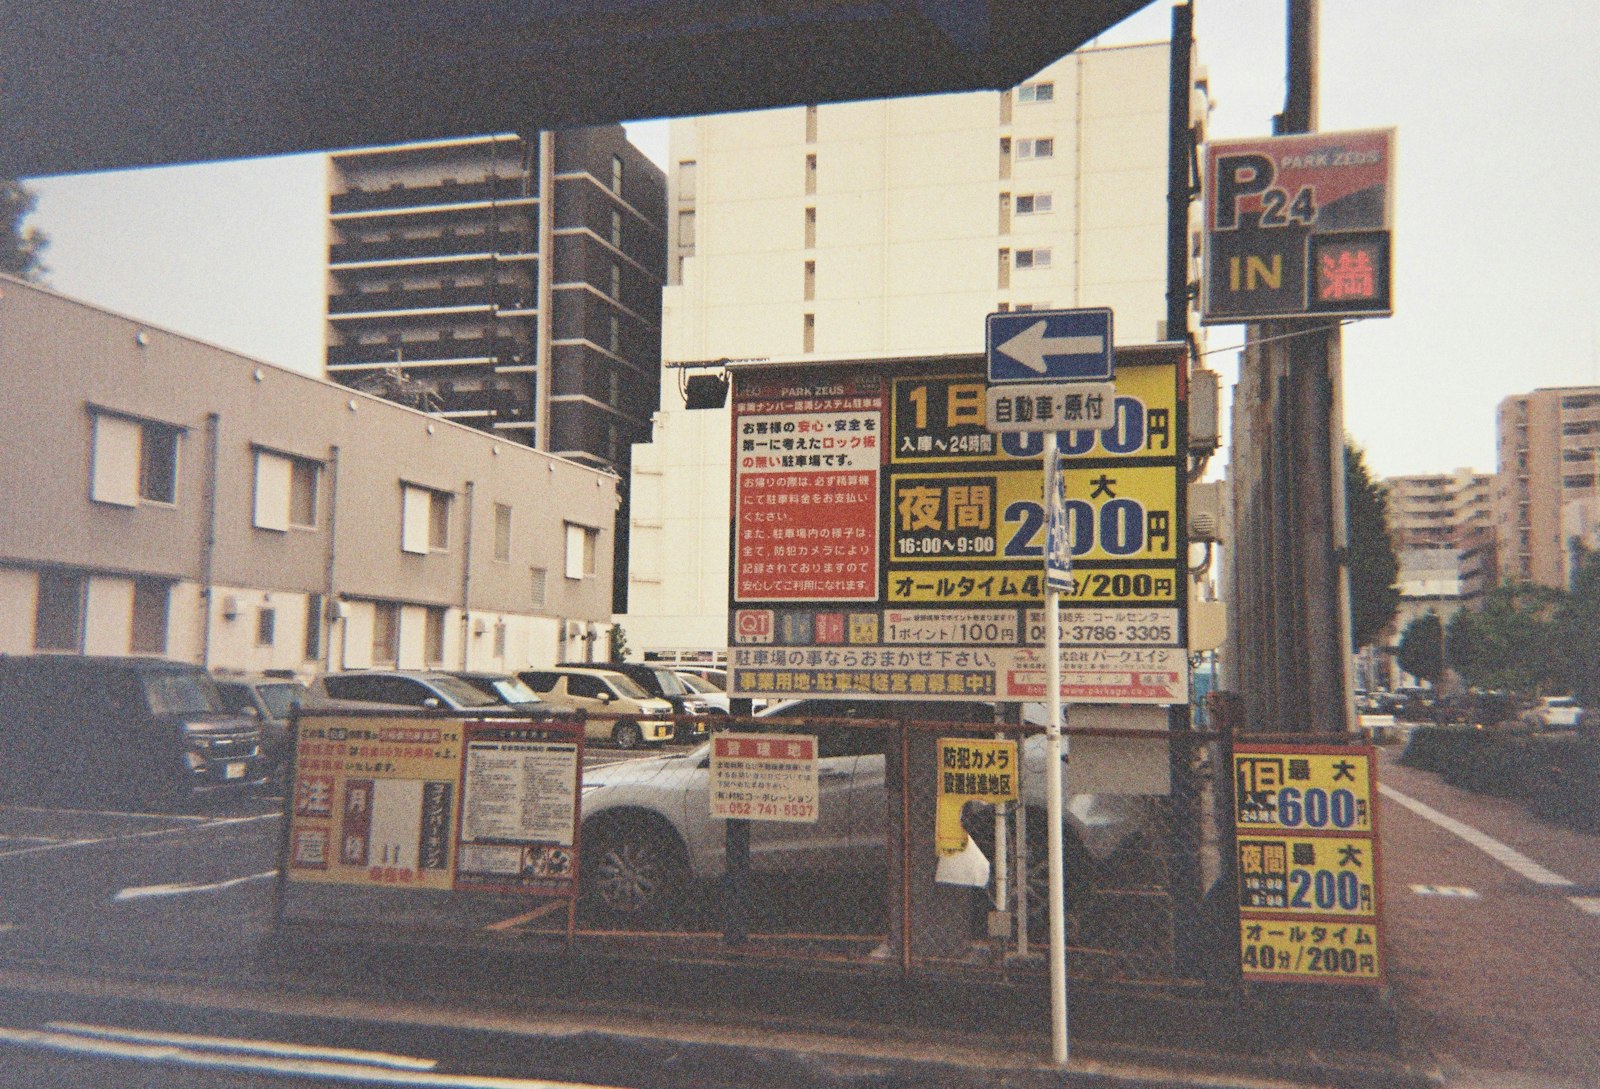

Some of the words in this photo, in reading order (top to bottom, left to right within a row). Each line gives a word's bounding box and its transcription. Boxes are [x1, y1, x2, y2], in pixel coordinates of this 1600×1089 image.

[1281, 154, 1328, 169] PARK
[1230, 255, 1282, 292] IN
[1322, 250, 1374, 299] 満
[781, 387, 811, 397] PARK
[815, 385, 844, 396] ZEUS
[909, 384, 987, 429] 1日
[996, 393, 1103, 422] 自動車・原付
[743, 435, 876, 452] 第一に考えたロック板
[742, 453, 853, 468] の無い駐車場です。
[744, 493, 868, 504] にて駐車料金をお支払い
[898, 486, 992, 531] 夜間
[744, 512, 793, 522] ください。
[743, 563, 868, 574] 記録されておりますので
[742, 580, 869, 591] 安心してご利用になれます。
[736, 649, 997, 668] 駐車場の事ならおまかせ下さい。
[943, 747, 1009, 769] 防犯カメラ
[1239, 760, 1280, 792] 1日
[1288, 759, 1355, 781] 最大
[943, 772, 1011, 795] 設置推進地区
[1278, 787, 1367, 828] 600円
[1242, 844, 1285, 874] 夜間
[1292, 843, 1362, 867] 最大
[1289, 868, 1370, 910] 200円
[1246, 923, 1372, 944] オールタイム
[1244, 944, 1374, 973] 40分/200円
